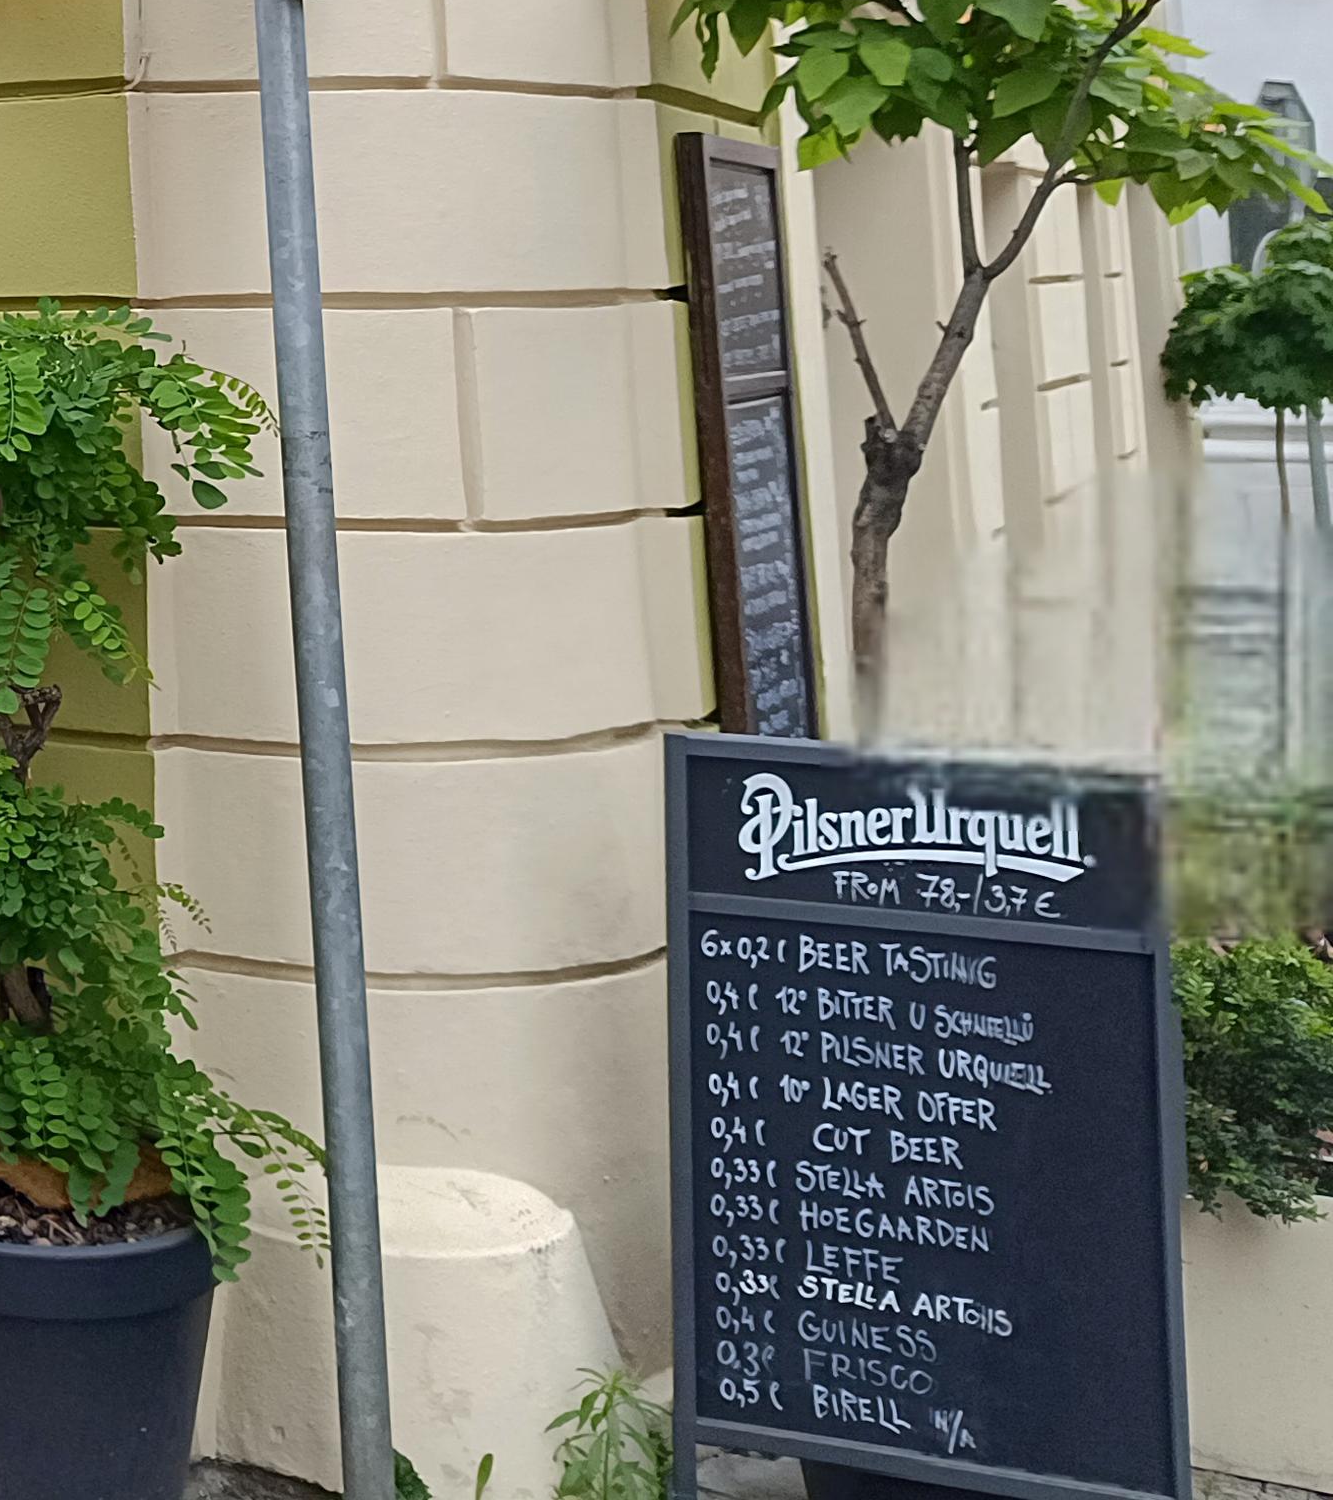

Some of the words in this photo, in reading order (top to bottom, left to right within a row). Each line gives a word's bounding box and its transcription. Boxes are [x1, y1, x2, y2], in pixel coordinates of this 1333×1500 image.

[833, 870, 901, 906] FROM
[798, 934, 871, 975] BEER
[817, 986, 896, 1031] BITTER
[909, 1001, 927, 1031] U
[820, 1030, 926, 1076] PILSNER
[822, 1075, 905, 1121] LAGER
[917, 1090, 997, 1132] OFFER
[812, 1122, 872, 1155] CUT
[889, 1129, 964, 1171] BEER
[795, 1160, 886, 1200] STELLA
[904, 1174, 995, 1216] ARTOIS
[798, 1199, 990, 1253] HOEGAARDEN
[805, 1239, 904, 1284] LEFFE
[797, 1275, 901, 1313] STELLA
[797, 1309, 938, 1362] GUINESS
[803, 1347, 934, 1395] FRISCO
[812, 1383, 912, 1435] BIRELL
